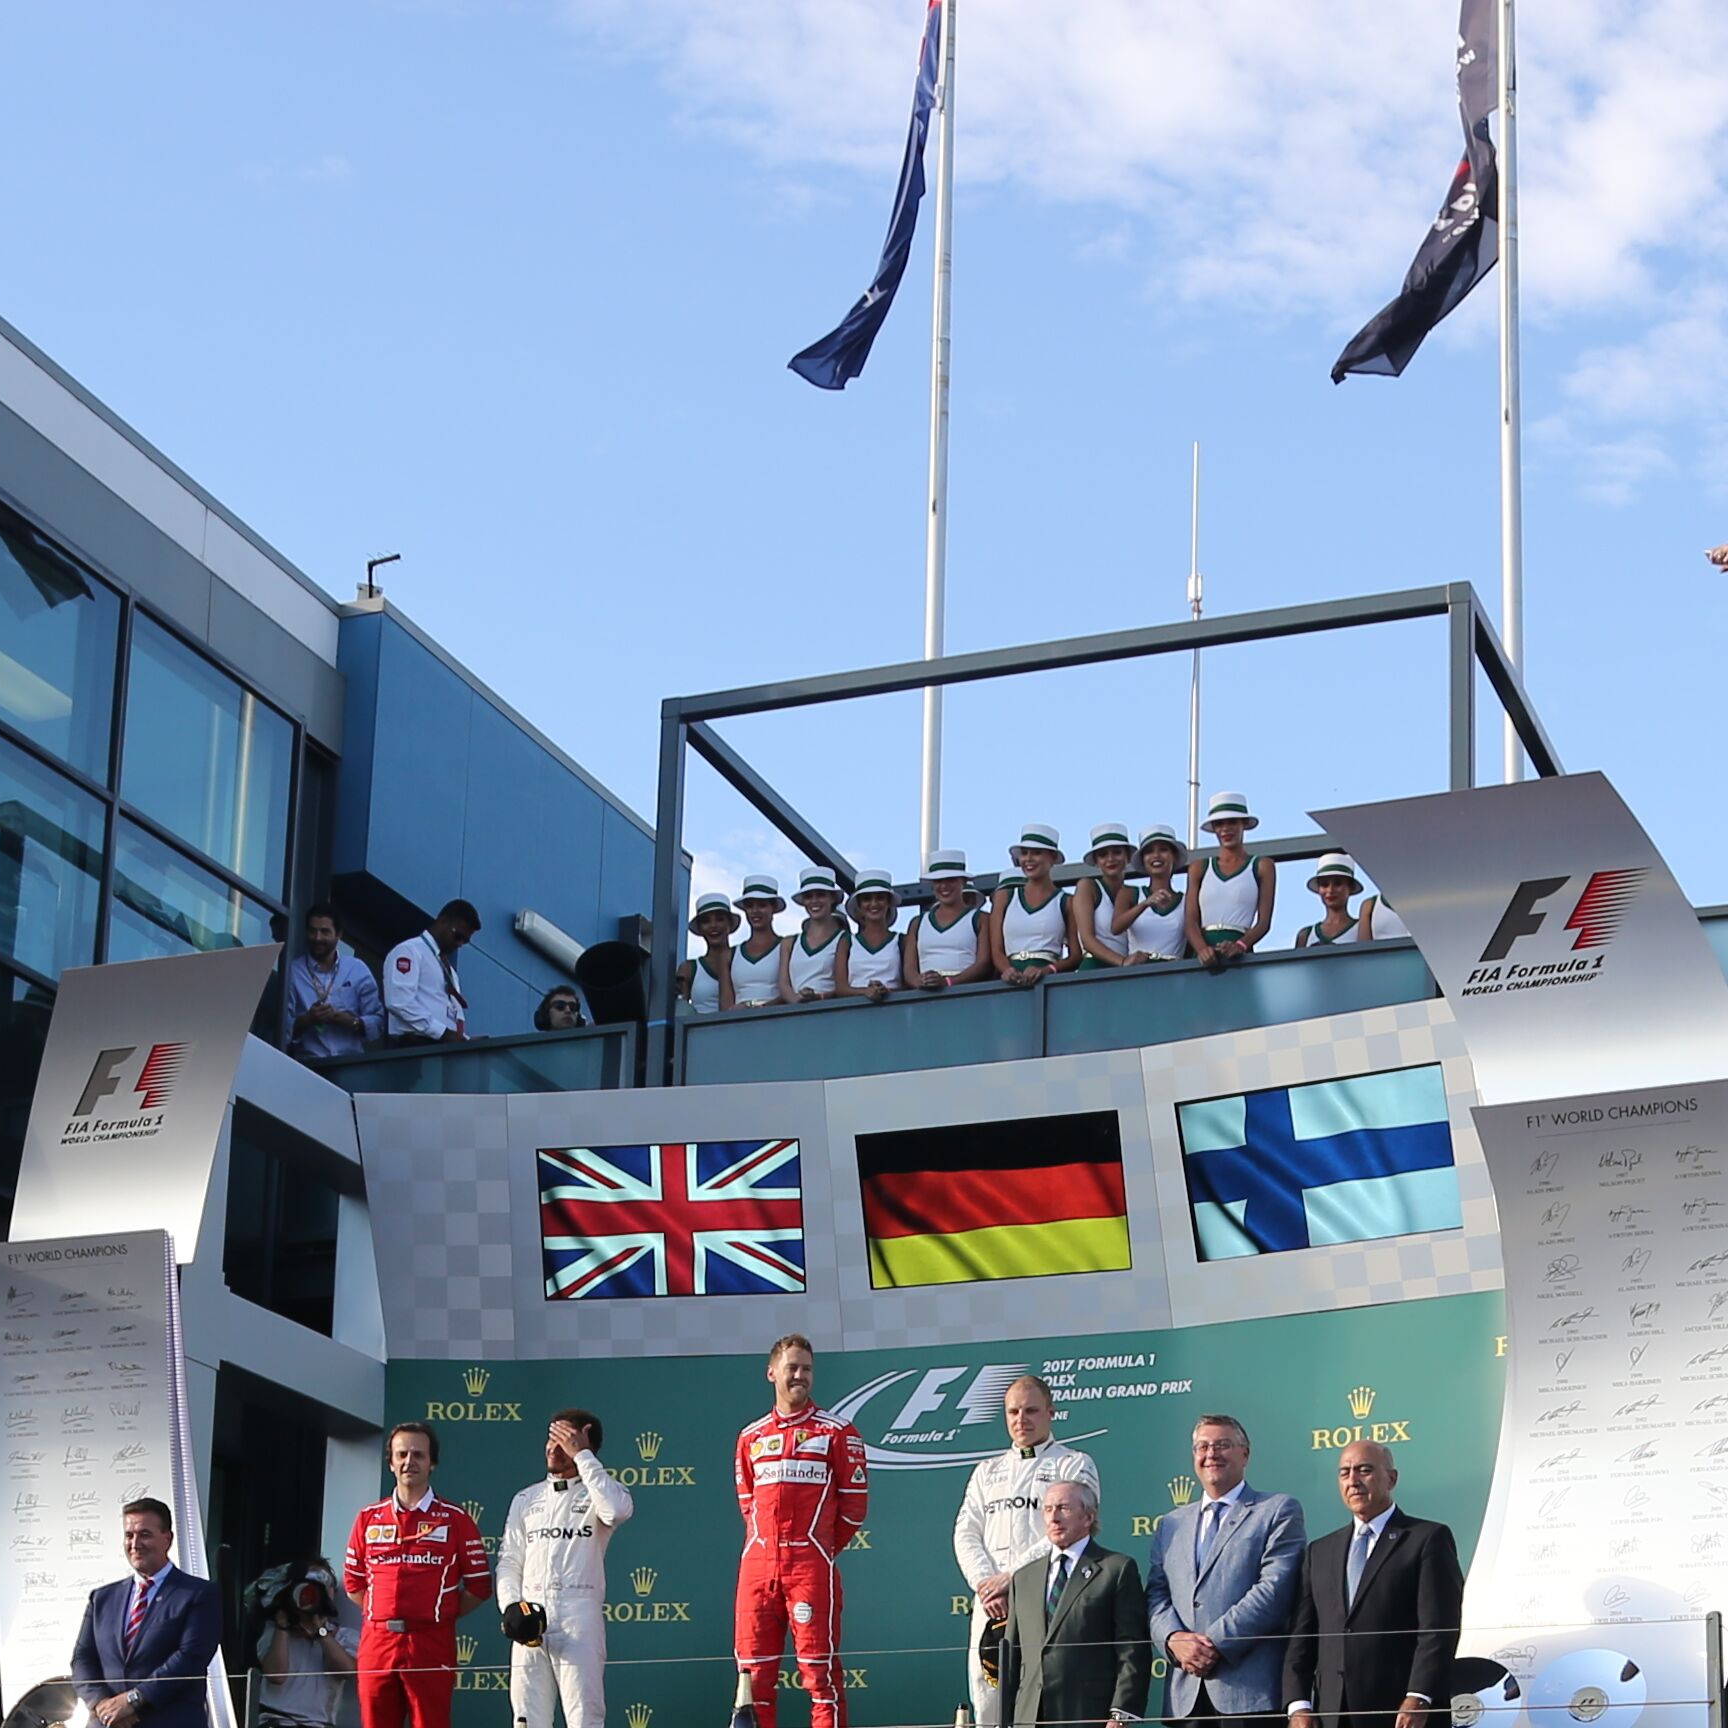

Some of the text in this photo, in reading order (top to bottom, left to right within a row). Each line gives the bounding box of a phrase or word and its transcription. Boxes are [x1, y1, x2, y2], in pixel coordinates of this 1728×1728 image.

[1467, 955, 1605, 984] FIA Formula 1
[1462, 984, 1503, 997] WORLD
[1552, 1109, 1603, 1125] WORLD
[1608, 1098, 1698, 1120] CHAMPIONS
[64, 1121, 90, 1135] FIA
[93, 1116, 152, 1132] Formula
[60, 1136, 90, 1145] WORLD
[25, 1250, 62, 1263] WORLD
[65, 1244, 128, 1260] CHAMPIONS
[1042, 1354, 1156, 1373] 2017 FORMULA 1
[1051, 1380, 1192, 1402] TRALIAN GRAND PRIX
[426, 1402, 522, 1421] ROLEX
[880, 1431, 943, 1445] Formula
[1311, 1421, 1411, 1449] ROLEX
[763, 1464, 828, 1481] Santander
[984, 1496, 1039, 1514] PETRON
[527, 1525, 593, 1543] ETRONAS
[380, 1551, 445, 1566] Santander
[454, 1671, 511, 1690] LEX
